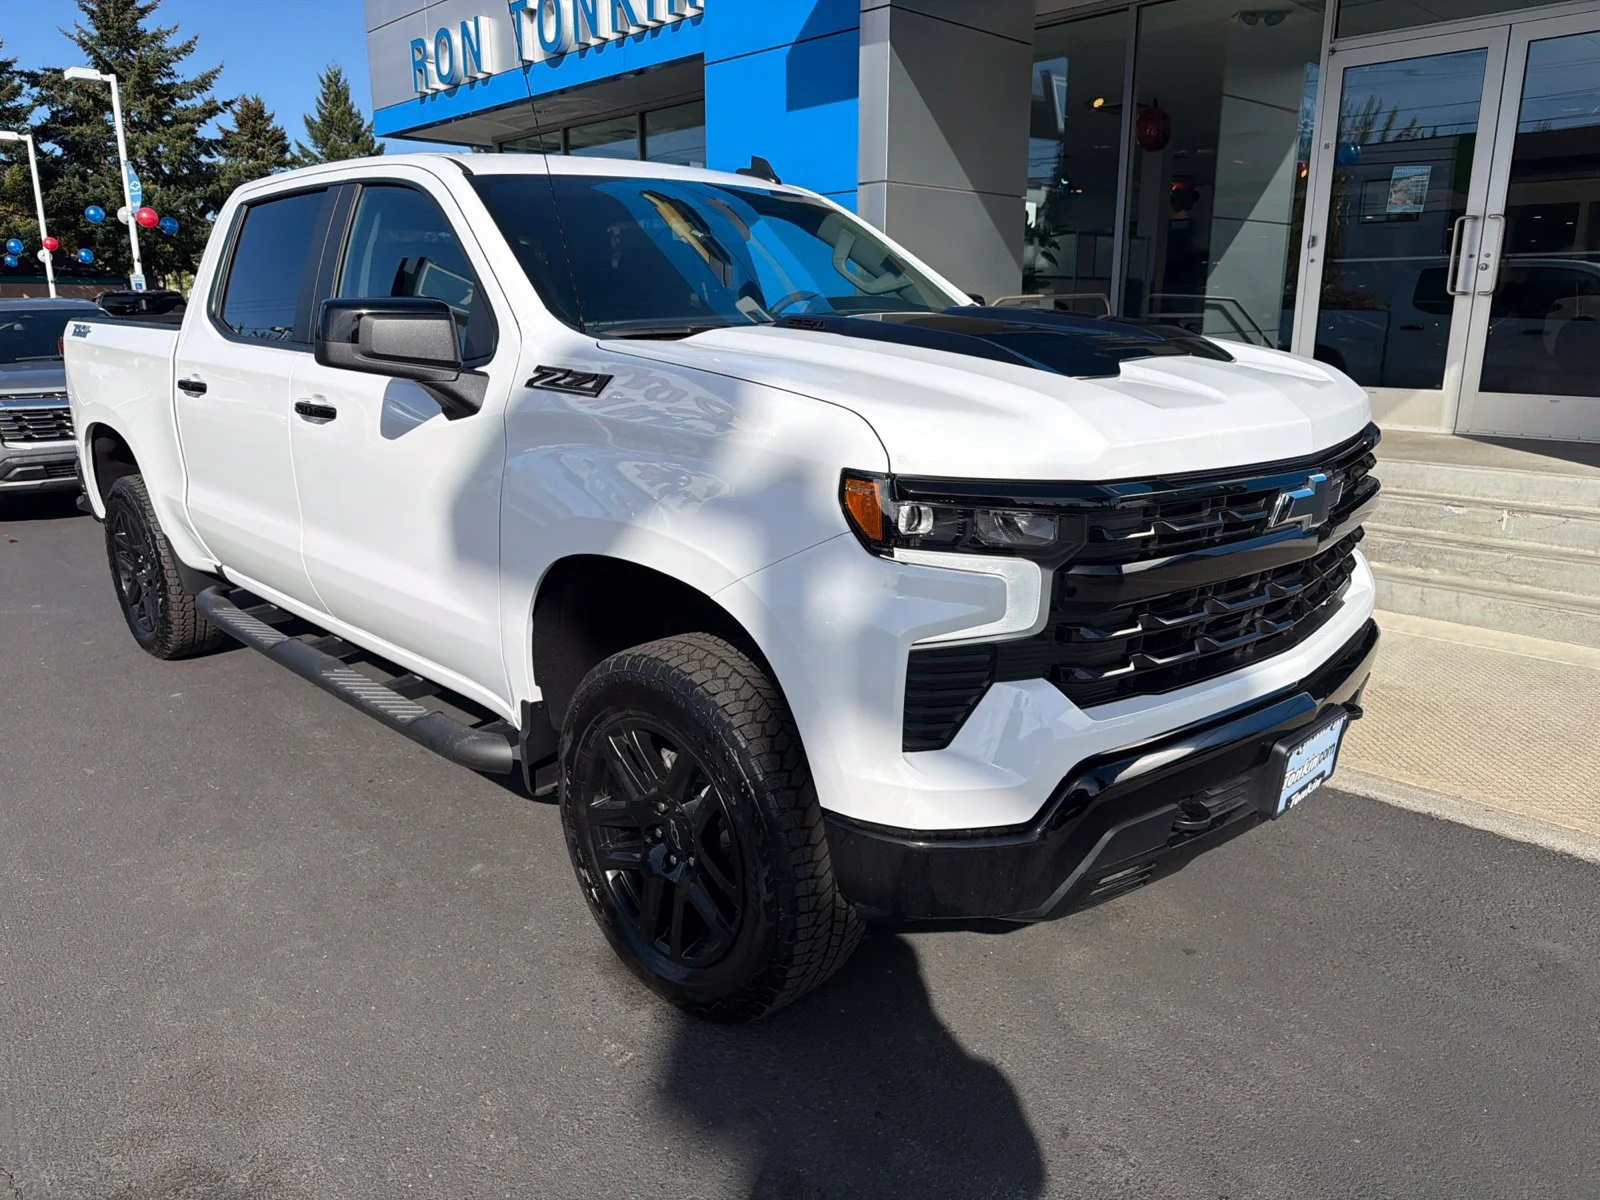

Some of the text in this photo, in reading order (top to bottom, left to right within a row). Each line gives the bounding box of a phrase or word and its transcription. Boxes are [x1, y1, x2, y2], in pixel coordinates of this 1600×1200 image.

[410, 0, 704, 93] RON TONK
[524, 365, 614, 398] Z71
[1282, 743, 1336, 790] Tonkin.com
[1289, 777, 1322, 808] Tonkin
